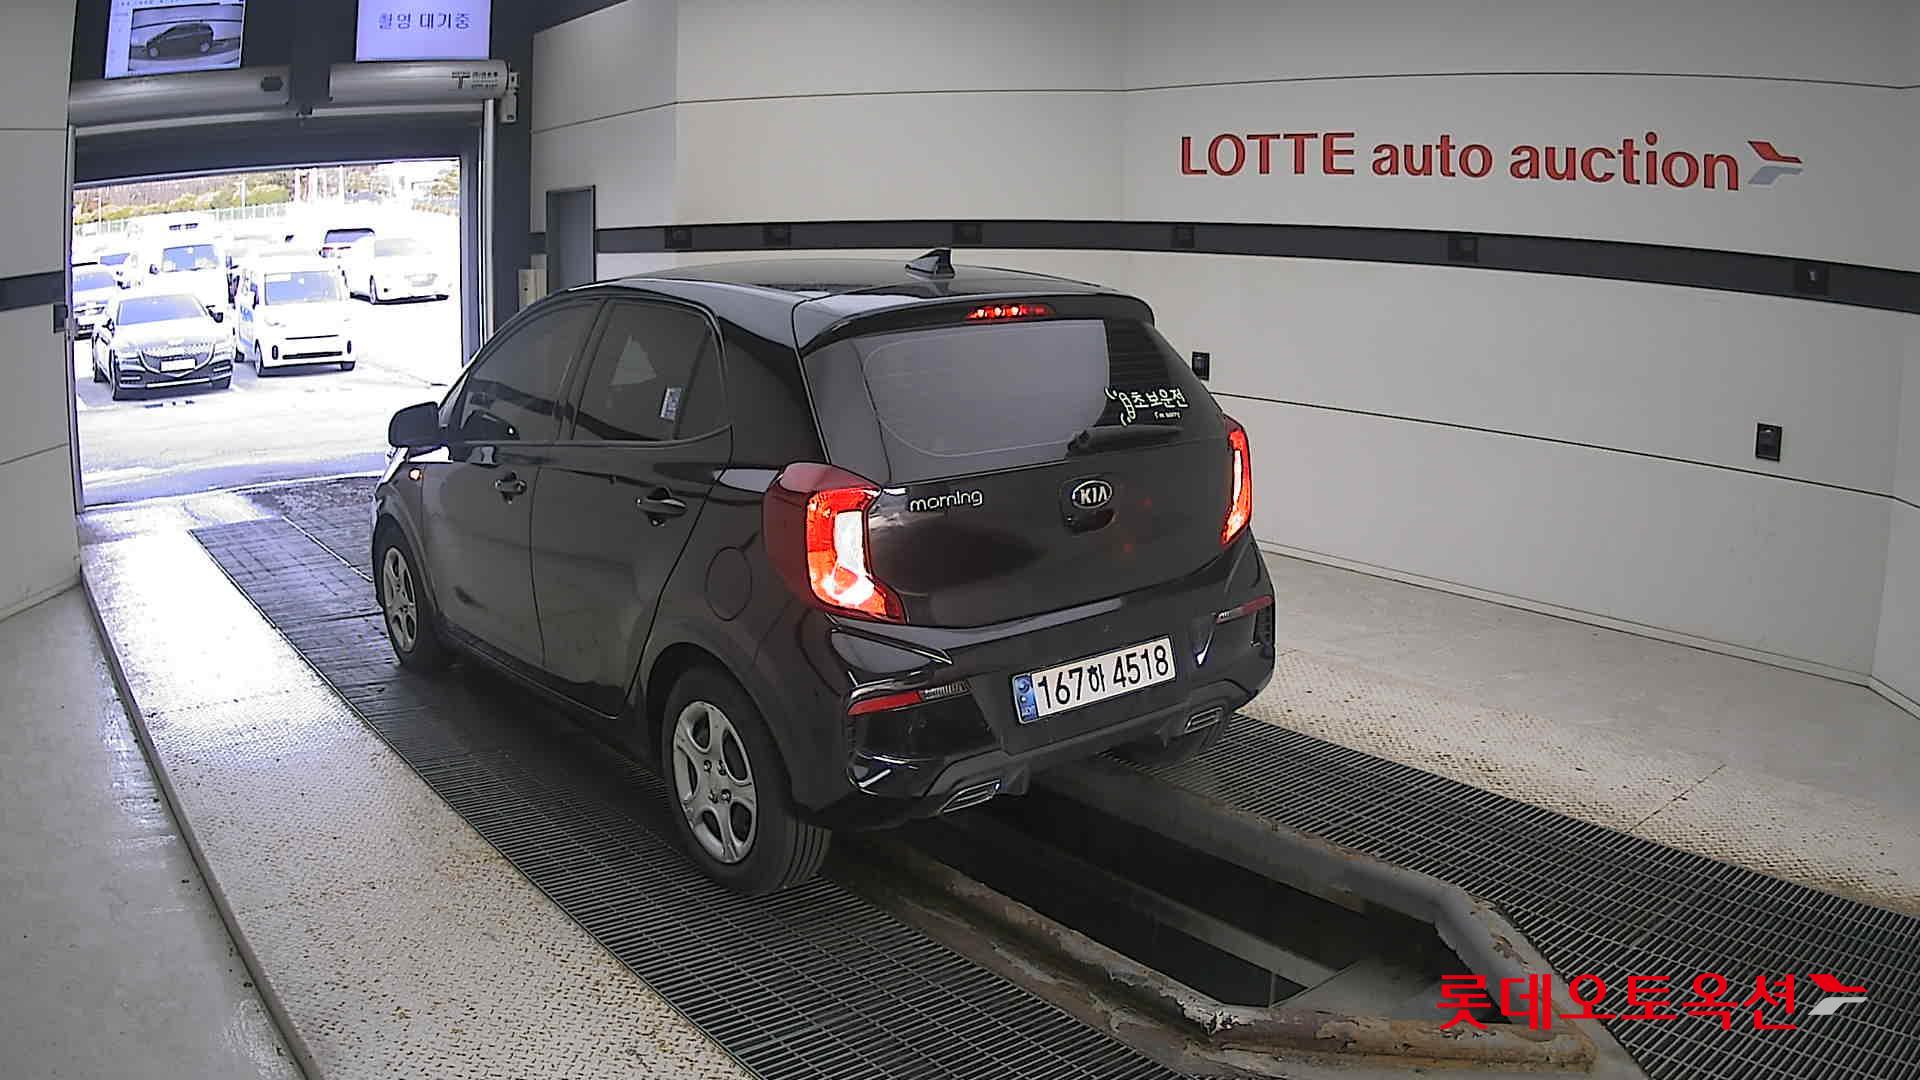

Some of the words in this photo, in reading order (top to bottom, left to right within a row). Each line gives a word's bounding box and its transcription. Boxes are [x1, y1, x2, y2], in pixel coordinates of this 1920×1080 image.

[420, 13, 470, 30] 대기중
[1181, 133, 1355, 175] LOTTE
[1372, 134, 1493, 178] auto
[1510, 131, 1739, 191] auction
[1131, 388, 1188, 408] 초보운전
[910, 490, 983, 512] morning
[1079, 487, 1108, 505] KIA
[1038, 663, 1106, 709] 167하
[1113, 645, 1169, 688] 4518
